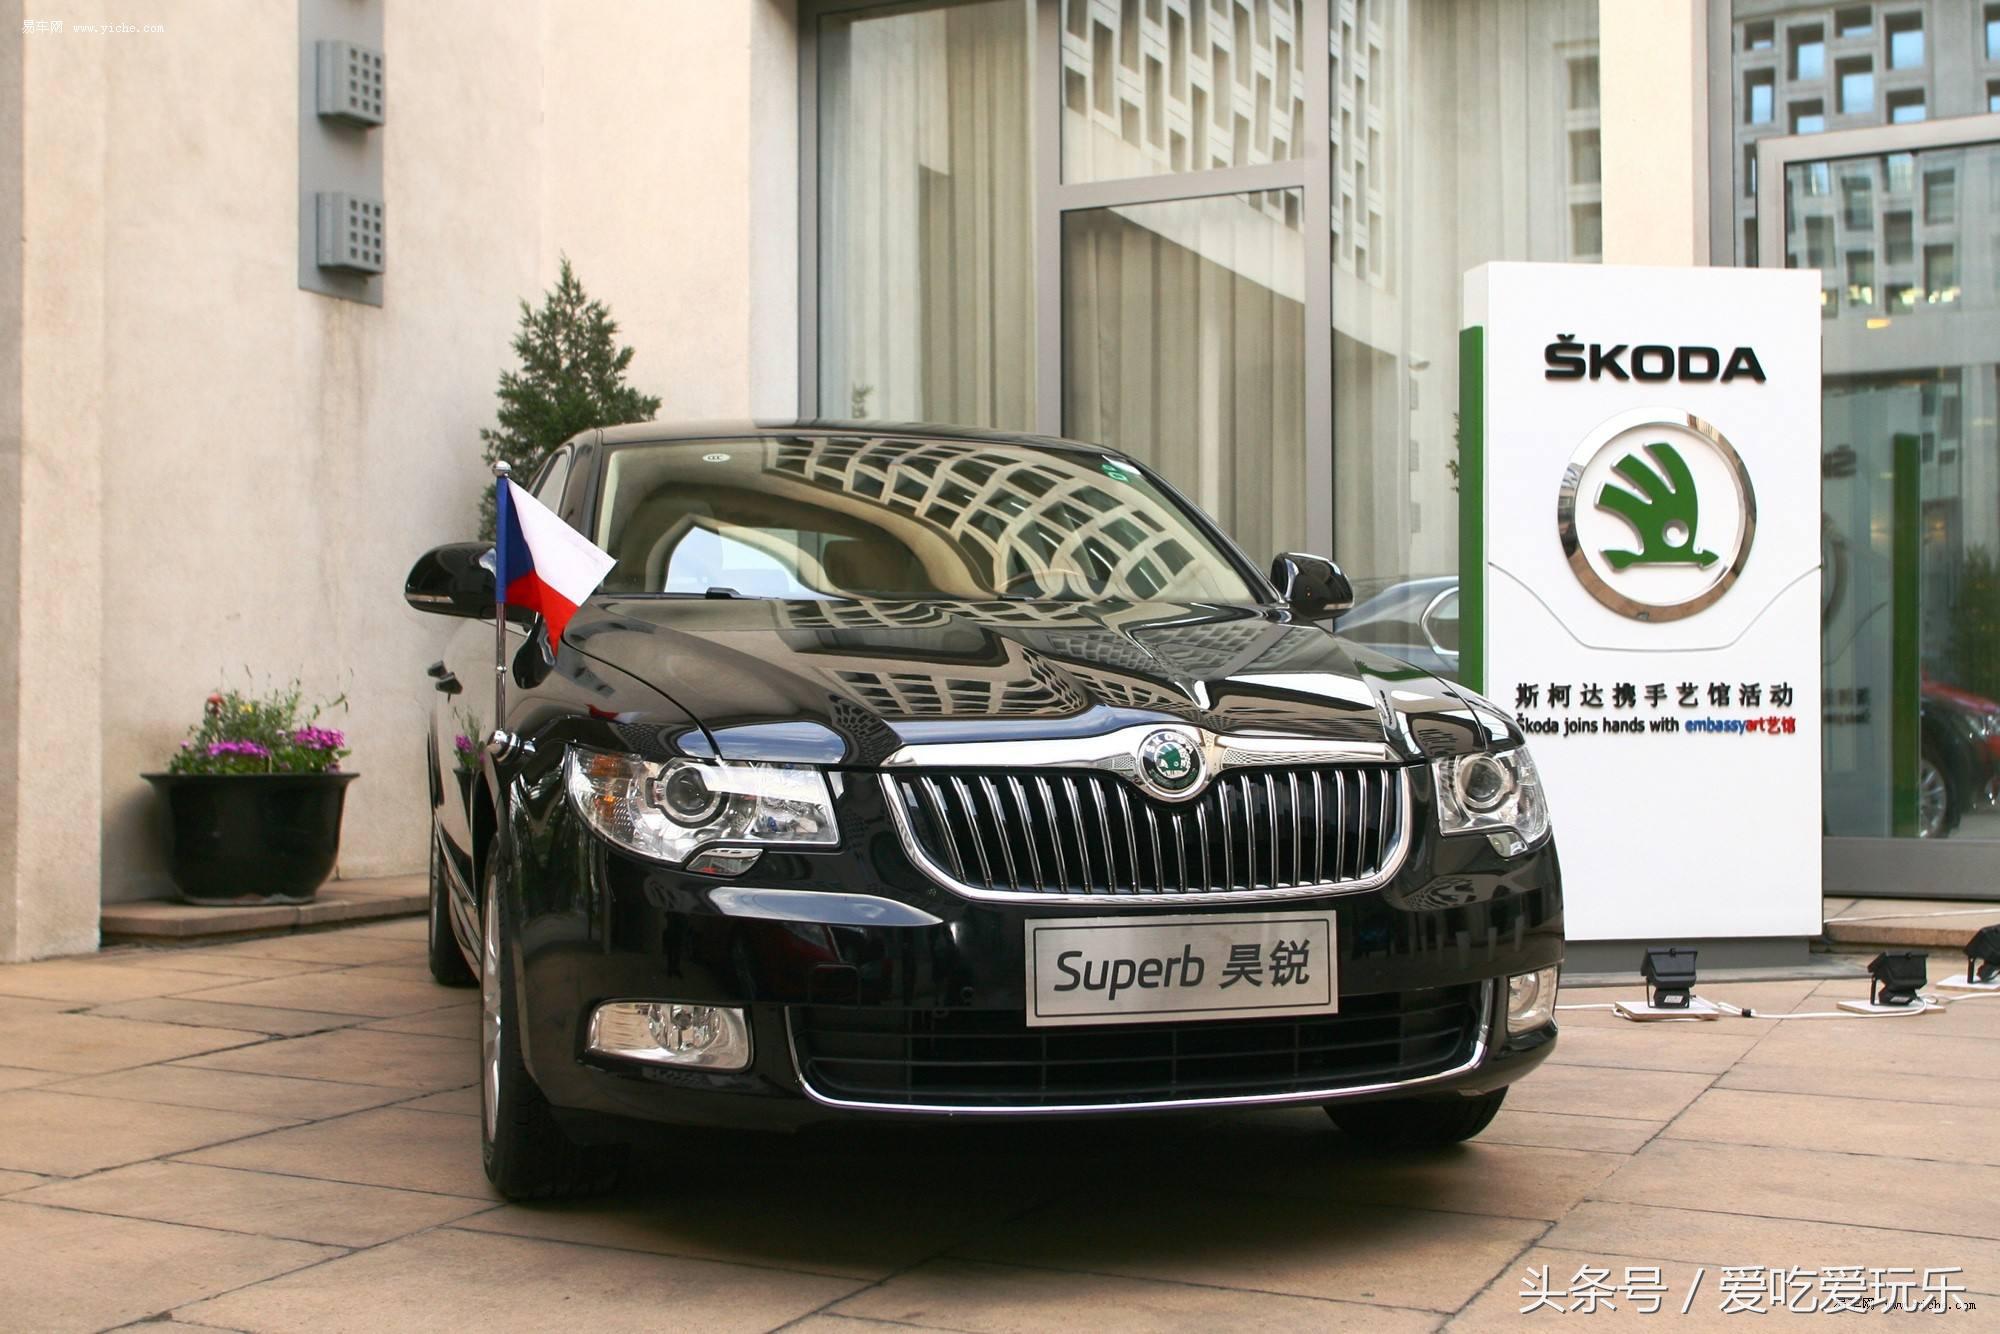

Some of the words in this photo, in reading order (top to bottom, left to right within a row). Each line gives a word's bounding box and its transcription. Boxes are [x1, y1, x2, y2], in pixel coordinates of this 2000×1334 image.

[1545, 334, 1766, 382] ŠKODA
[1515, 682, 1793, 708] 斯柯达携手艺馆活动
[1563, 715, 1598, 737] joins
[1603, 715, 1645, 733] hands
[1649, 715, 1680, 733] with
[1054, 944, 1205, 1001] Superb
[1219, 939, 1311, 990] 昊锐
